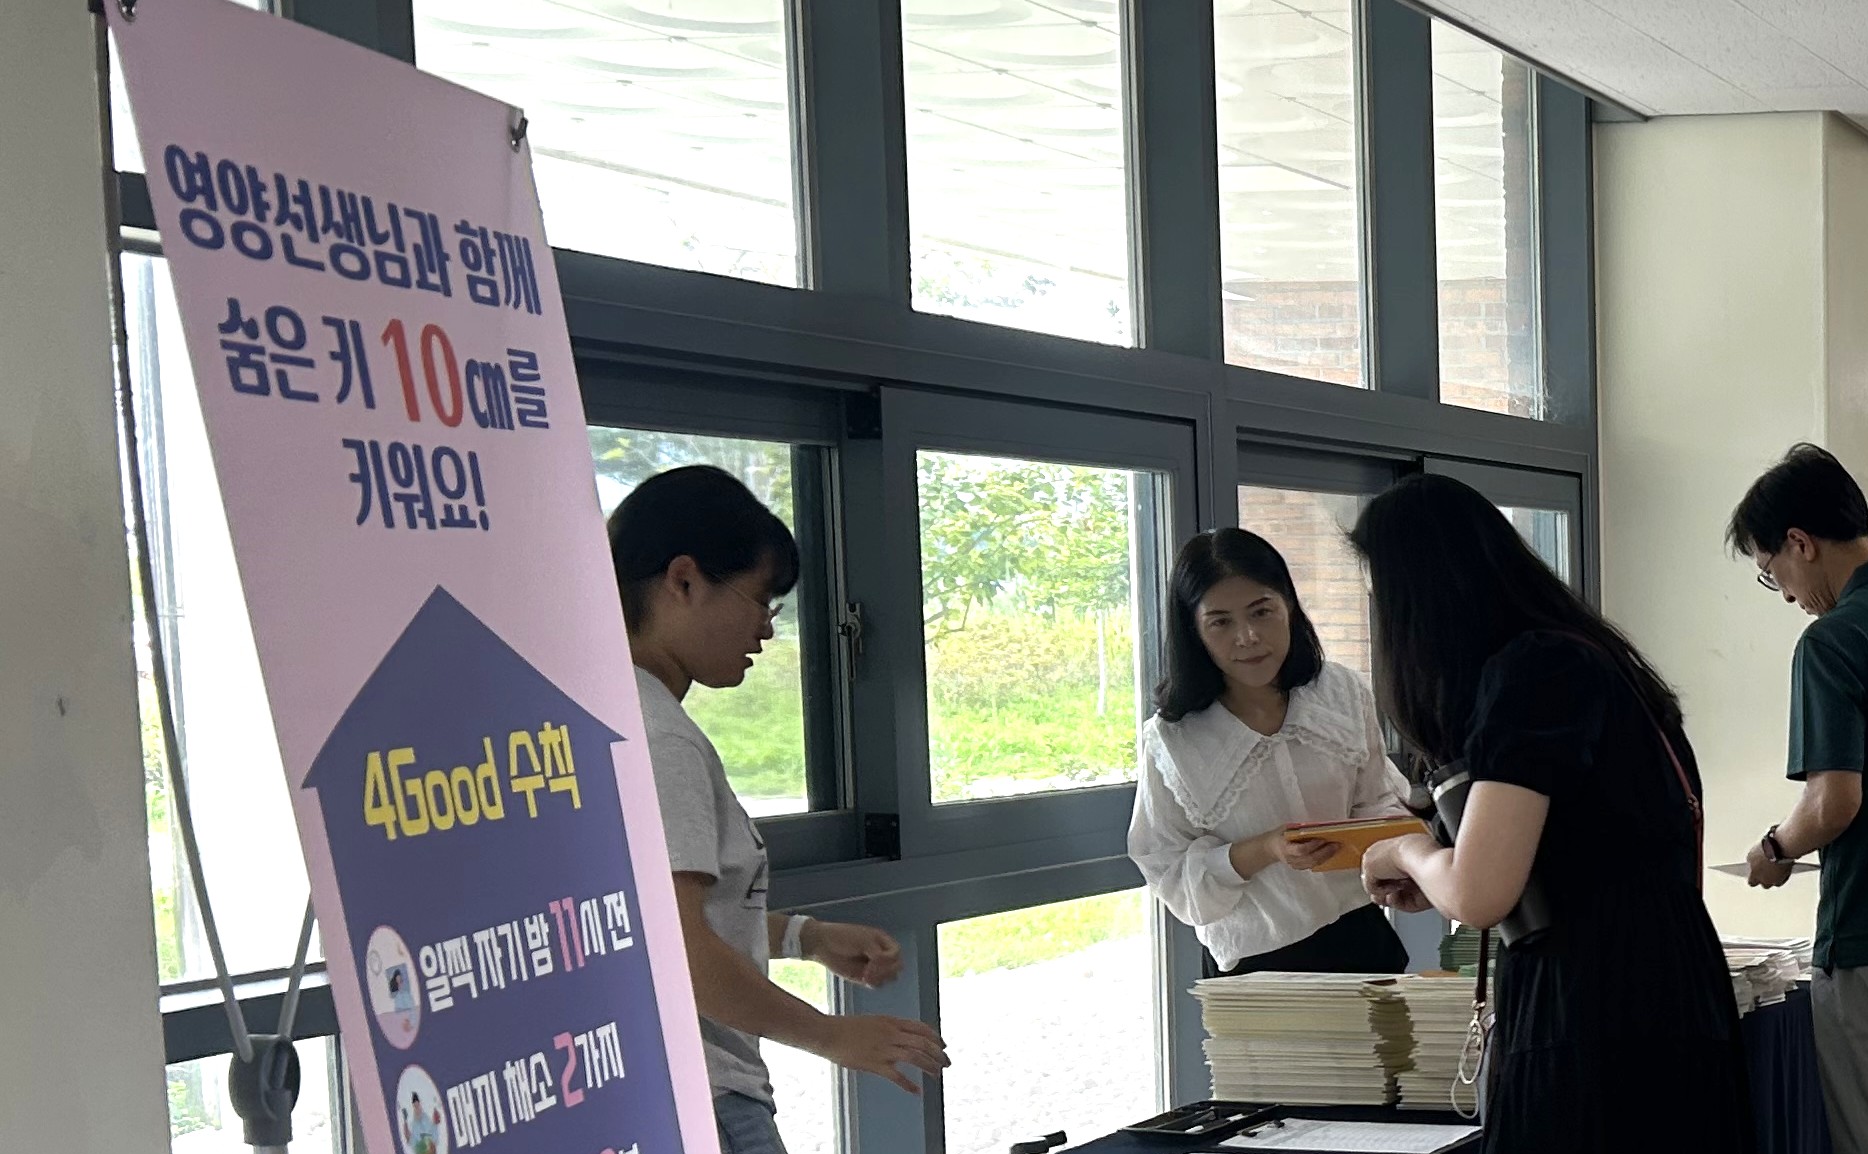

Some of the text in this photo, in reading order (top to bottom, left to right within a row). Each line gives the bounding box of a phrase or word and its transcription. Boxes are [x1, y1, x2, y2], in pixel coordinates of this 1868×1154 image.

[164, 144, 542, 315] 영양선생님과 함께
[218, 297, 319, 402] 숨은
[322, 316, 376, 409] 키
[342, 438, 489, 531] 키워요!
[363, 721, 582, 840] 4Good 수칙
[419, 890, 634, 1012] 일찍 자기 밤 11시 전
[446, 1021, 625, 1148] 매끼 채소 2가지
